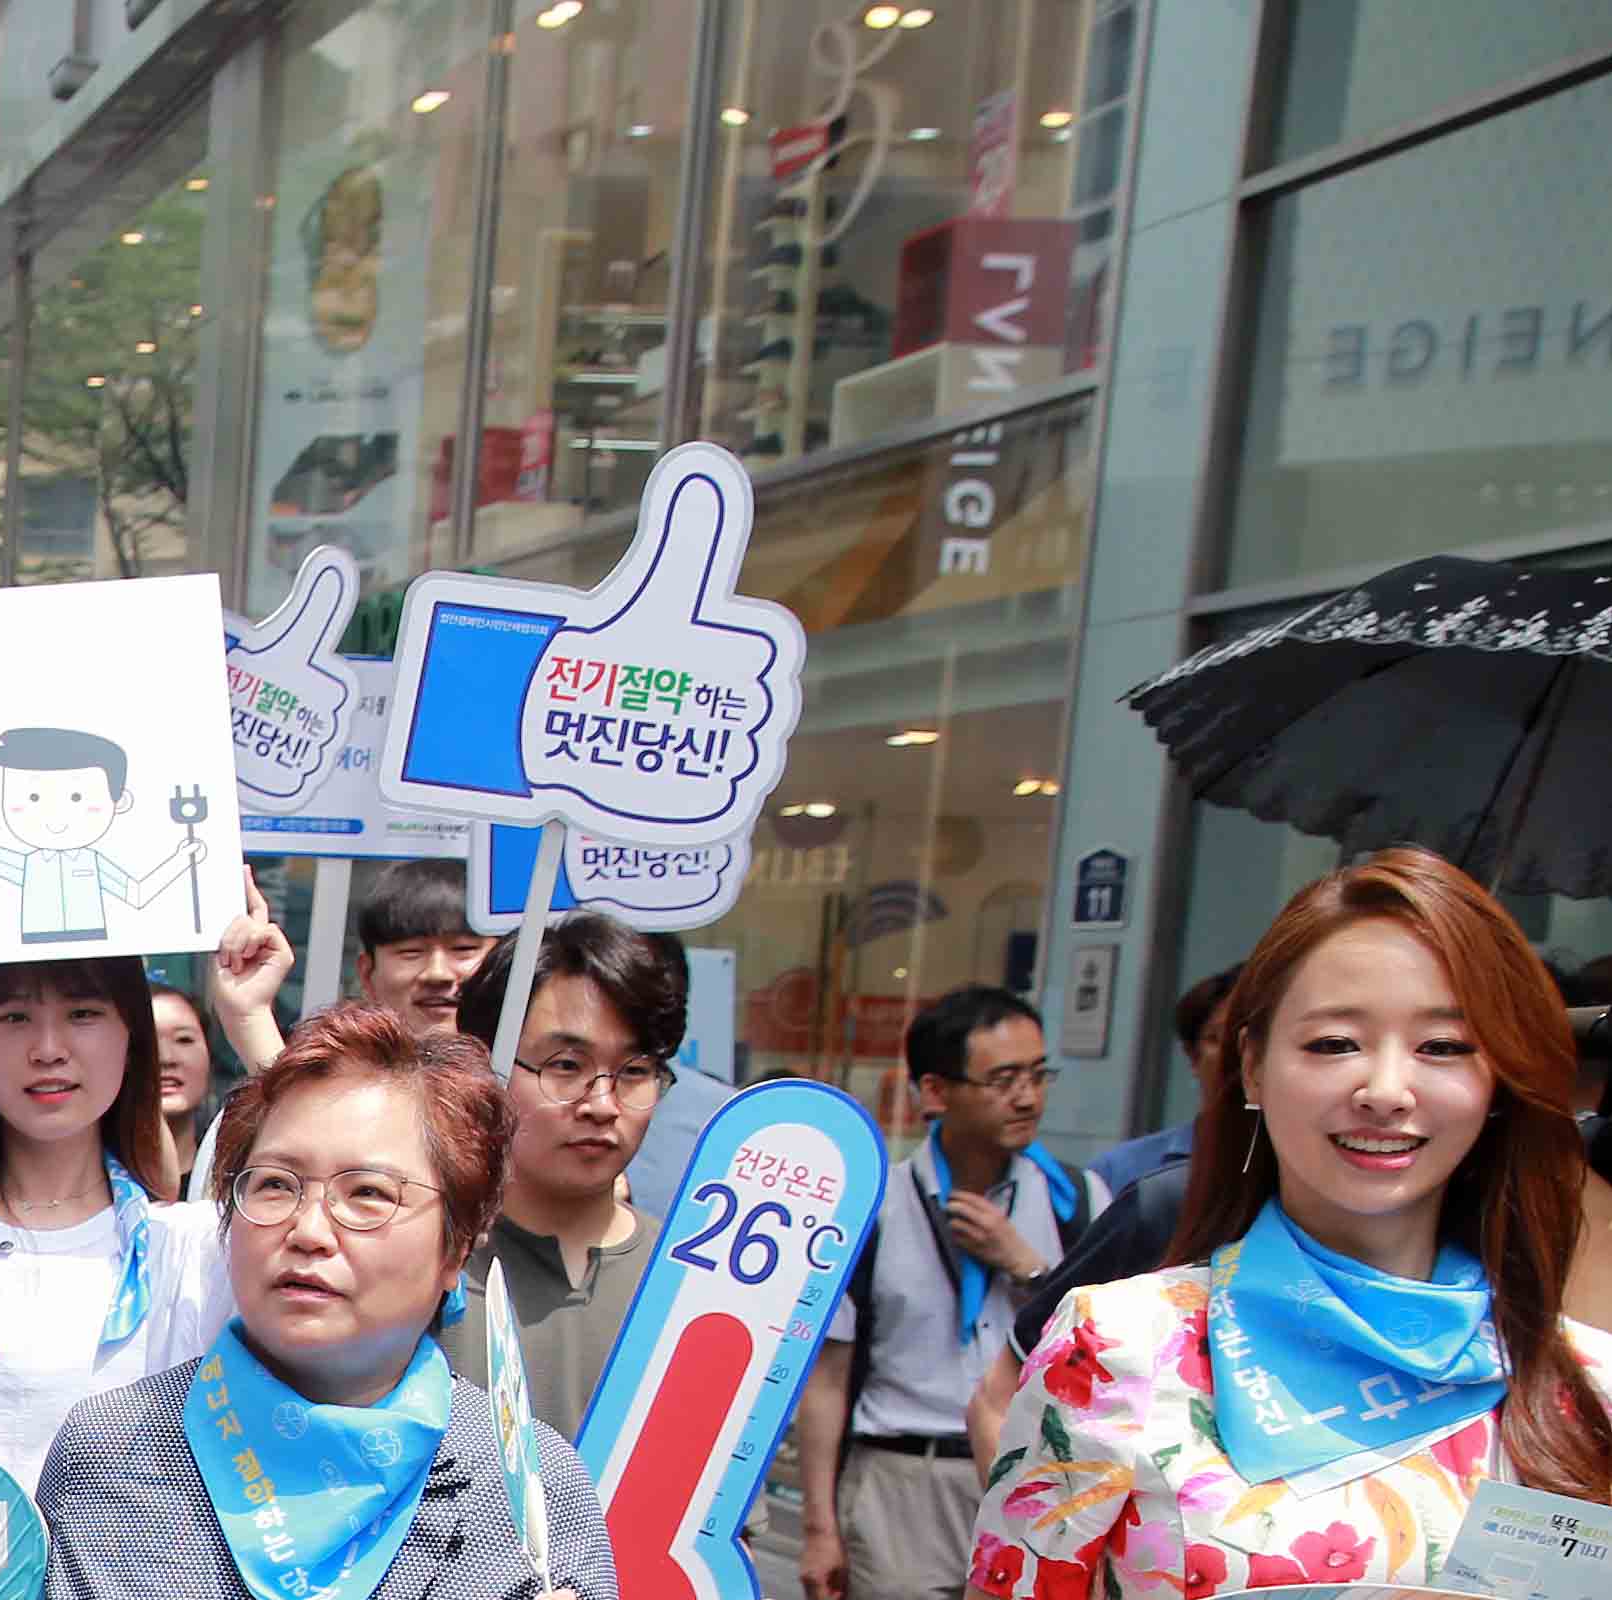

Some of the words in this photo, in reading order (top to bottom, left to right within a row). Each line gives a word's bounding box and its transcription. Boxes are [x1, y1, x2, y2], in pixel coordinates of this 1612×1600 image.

[232, 706, 311, 769] 진당신!
[544, 709, 732, 778] 멋진당신!
[735, 1146, 837, 1205] 건강온도
[806, 1286, 824, 1302] 30
[789, 1319, 813, 1342] 26
[200, 1353, 244, 1441] 에너지
[771, 1364, 790, 1380] 20
[1232, 1364, 1293, 1436] 당신
